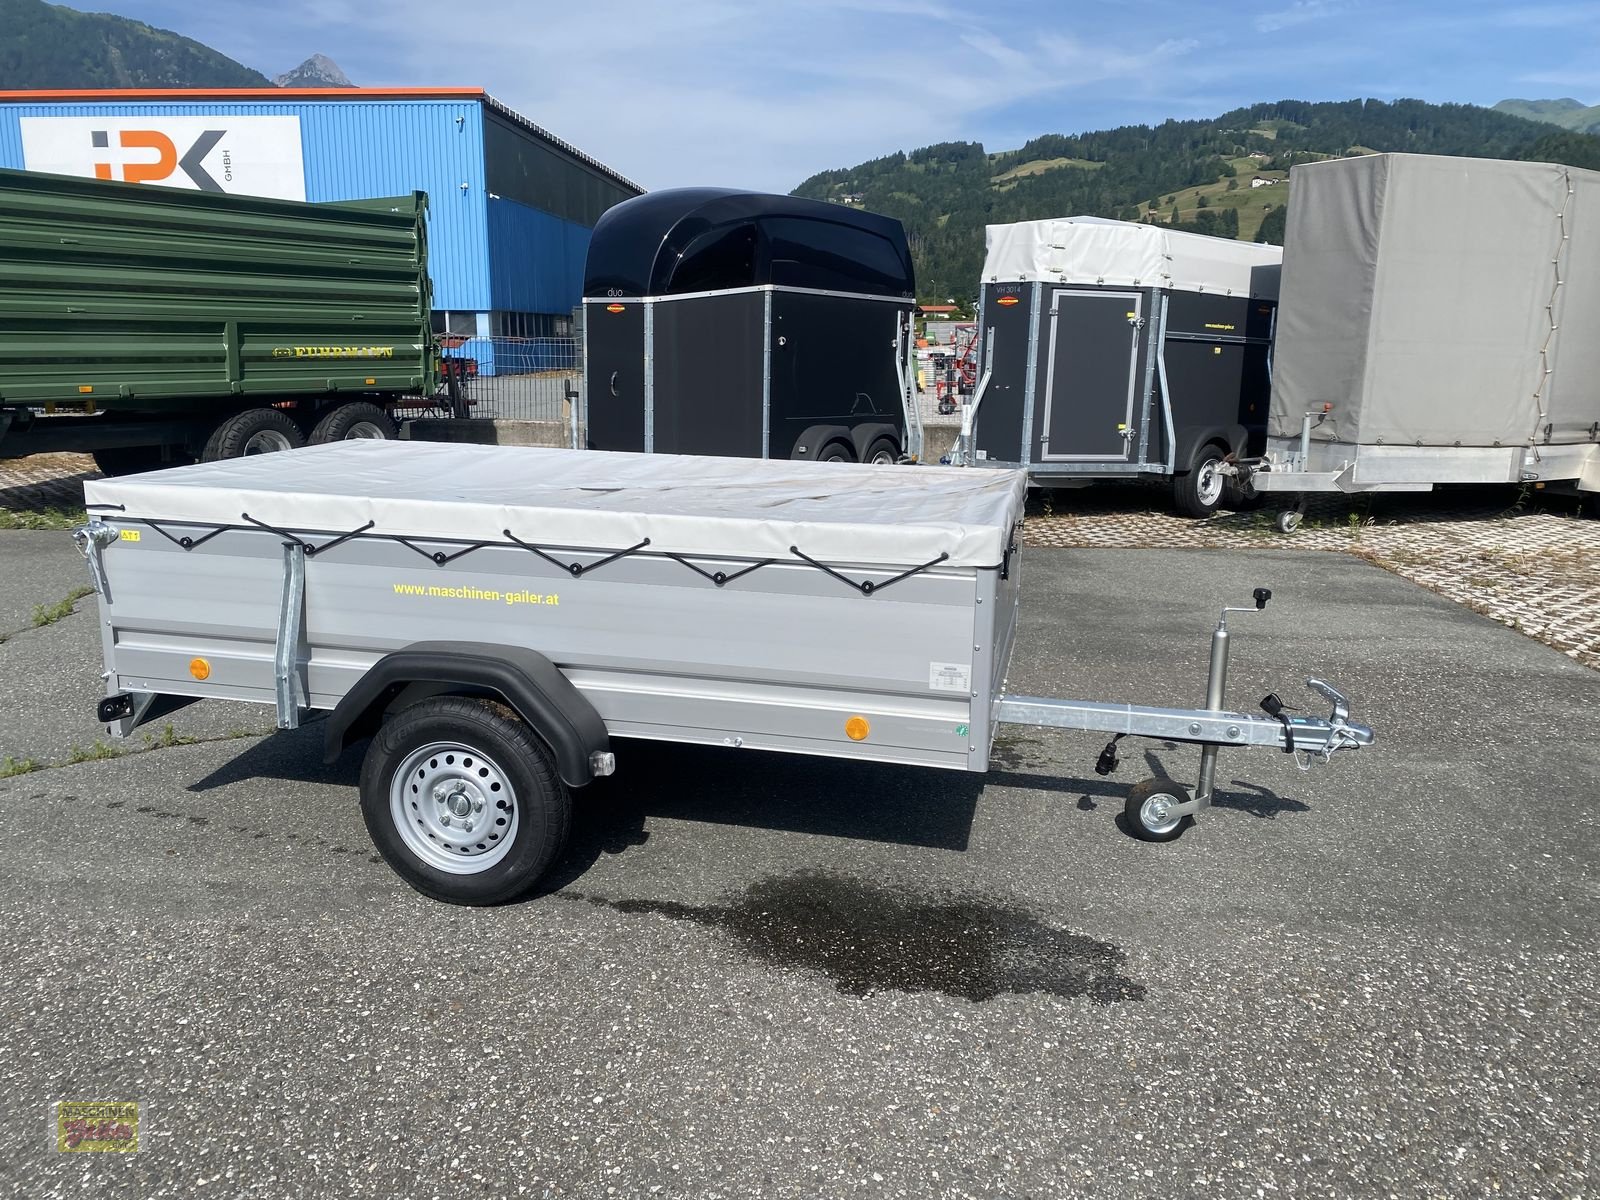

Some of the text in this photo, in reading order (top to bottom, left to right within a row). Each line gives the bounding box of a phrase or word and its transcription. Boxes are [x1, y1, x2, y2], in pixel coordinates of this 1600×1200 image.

[607, 288, 623, 297] duo
[294, 346, 395, 358] FUHRMANN
[393, 583, 559, 605] www.maschinen-gailer.at
